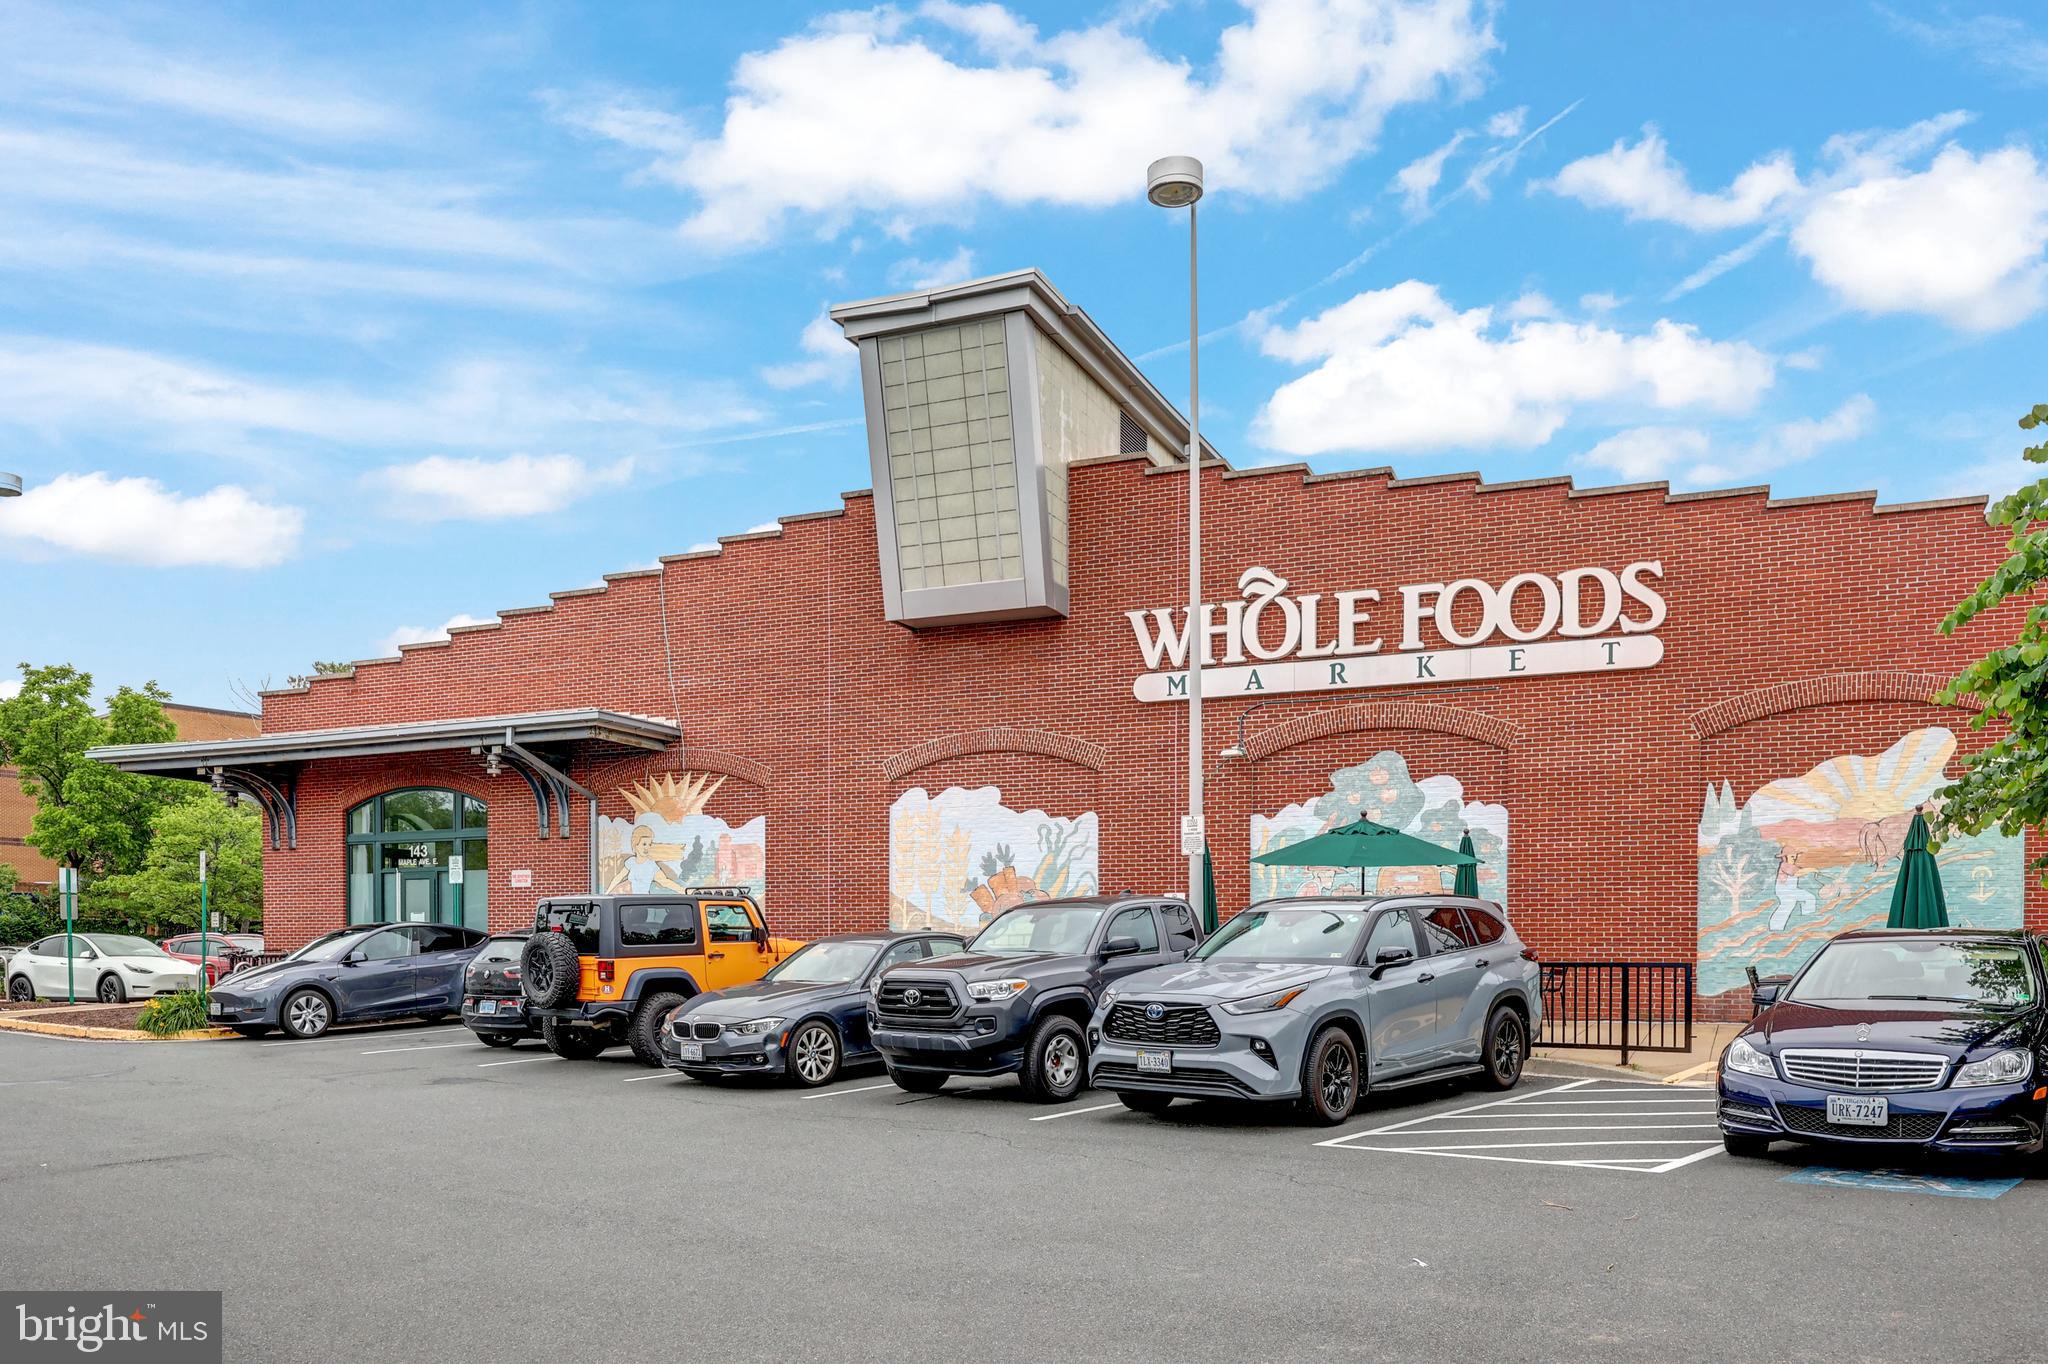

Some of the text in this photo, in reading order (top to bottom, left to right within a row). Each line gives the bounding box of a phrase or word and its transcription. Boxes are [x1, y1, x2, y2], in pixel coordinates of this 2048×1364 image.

[1124, 560, 1668, 670] WHOLE FOODS
[1167, 641, 1622, 697] MARKET
[409, 844, 428, 858] 143
[398, 858, 417, 866] MAPLE
[1832, 1103, 1884, 1118] URK-7247
